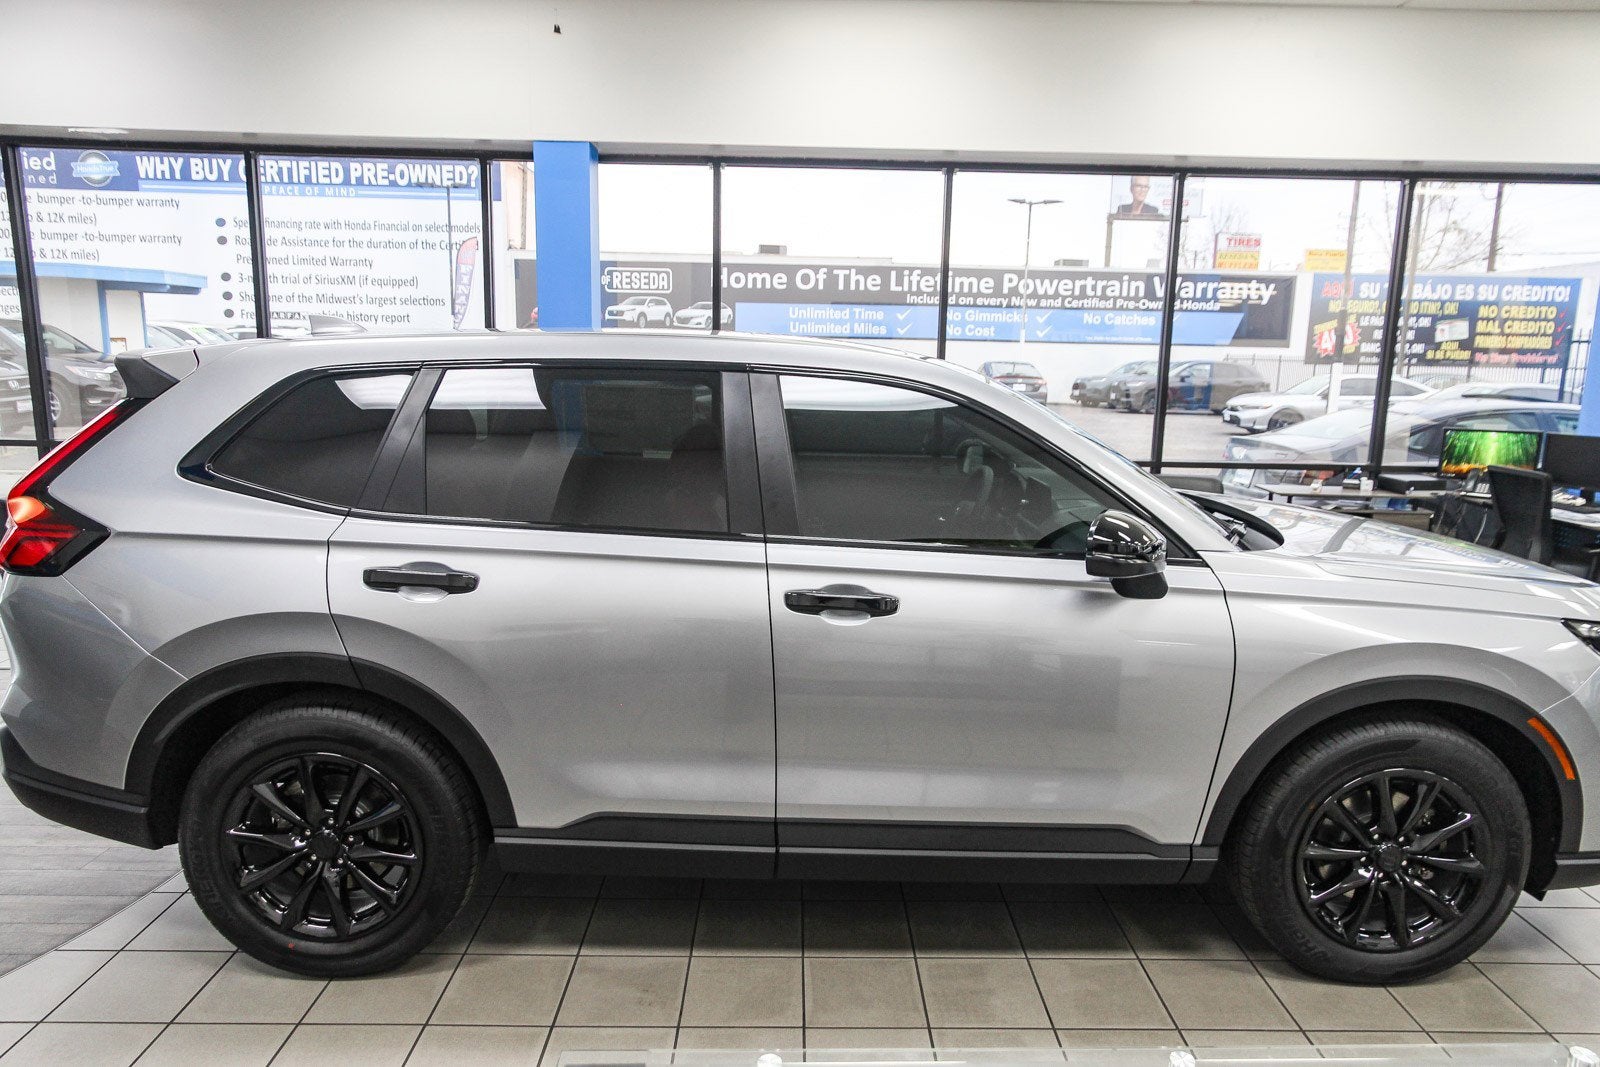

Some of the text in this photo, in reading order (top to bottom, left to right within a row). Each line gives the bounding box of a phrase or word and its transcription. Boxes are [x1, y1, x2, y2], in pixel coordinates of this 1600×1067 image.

[135, 155, 184, 180] WHY
[190, 158, 232, 181] BUY
[350, 162, 479, 188] PRE-OWNED?
[264, 186, 356, 197] PEACE OF MIND
[37, 193, 75, 206] bumper
[136, 198, 180, 210] warranty
[47, 212, 66, 224] 12K
[68, 212, 97, 226] miles)
[305, 219, 321, 230] rate
[323, 218, 342, 230] with
[344, 220, 371, 231] Honda
[373, 220, 410, 232] Financial
[411, 223, 423, 232] on
[424, 222, 450, 233] select
[450, 222, 481, 233] models
[40, 229, 79, 243] bumper
[138, 233, 182, 246] warranty
[280, 236, 329, 248] Assistance
[332, 237, 346, 248] for
[348, 238, 364, 249] the
[366, 238, 408, 250] duration
[409, 239, 418, 250] of
[421, 240, 437, 250] the
[50, 248, 69, 260] 12K
[70, 248, 100, 262] miles)
[291, 254, 327, 267] Limited
[329, 255, 373, 269] Warranty
[281, 273, 300, 284] trial
[302, 273, 313, 285] of
[314, 274, 356, 286] SiriusXM
[359, 275, 369, 288] (if
[371, 276, 419, 289] equipped)
[601, 271, 668, 289] OF RESEDA
[710, 266, 1276, 305] Home Of The Lifetime Powertrain Warranty
[285, 292, 296, 303] of
[298, 293, 314, 304] the
[315, 293, 364, 305] Midwest's
[365, 294, 398, 308] largest
[399, 295, 446, 306] selections
[1359, 282, 1381, 299] SU
[1454, 284, 1475, 301] ES
[1476, 283, 1499, 301] SU
[1501, 284, 1571, 302] CREDITO!
[906, 293, 956, 305] Includd
[958, 296, 974, 305] on
[976, 297, 1009, 308] every
[1011, 296, 1038, 307] New
[1040, 296, 1062, 307] and
[1064, 297, 1114, 309] Certified
[1183, 300, 1221, 311] Honda
[346, 312, 379, 322] history
[381, 313, 411, 323] report
[789, 307, 850, 321] Unlimited
[853, 307, 884, 320] Time
[964, 310, 1029, 323] Gimmicks
[1083, 312, 1101, 325] No
[1104, 313, 1157, 326] Catches
[1478, 305, 1558, 320] NO CREDITO
[789, 321, 850, 334] Unlimited
[853, 322, 887, 335] Miles
[964, 325, 995, 337] Cost
[1476, 320, 1556, 335] MAL CREDITO
